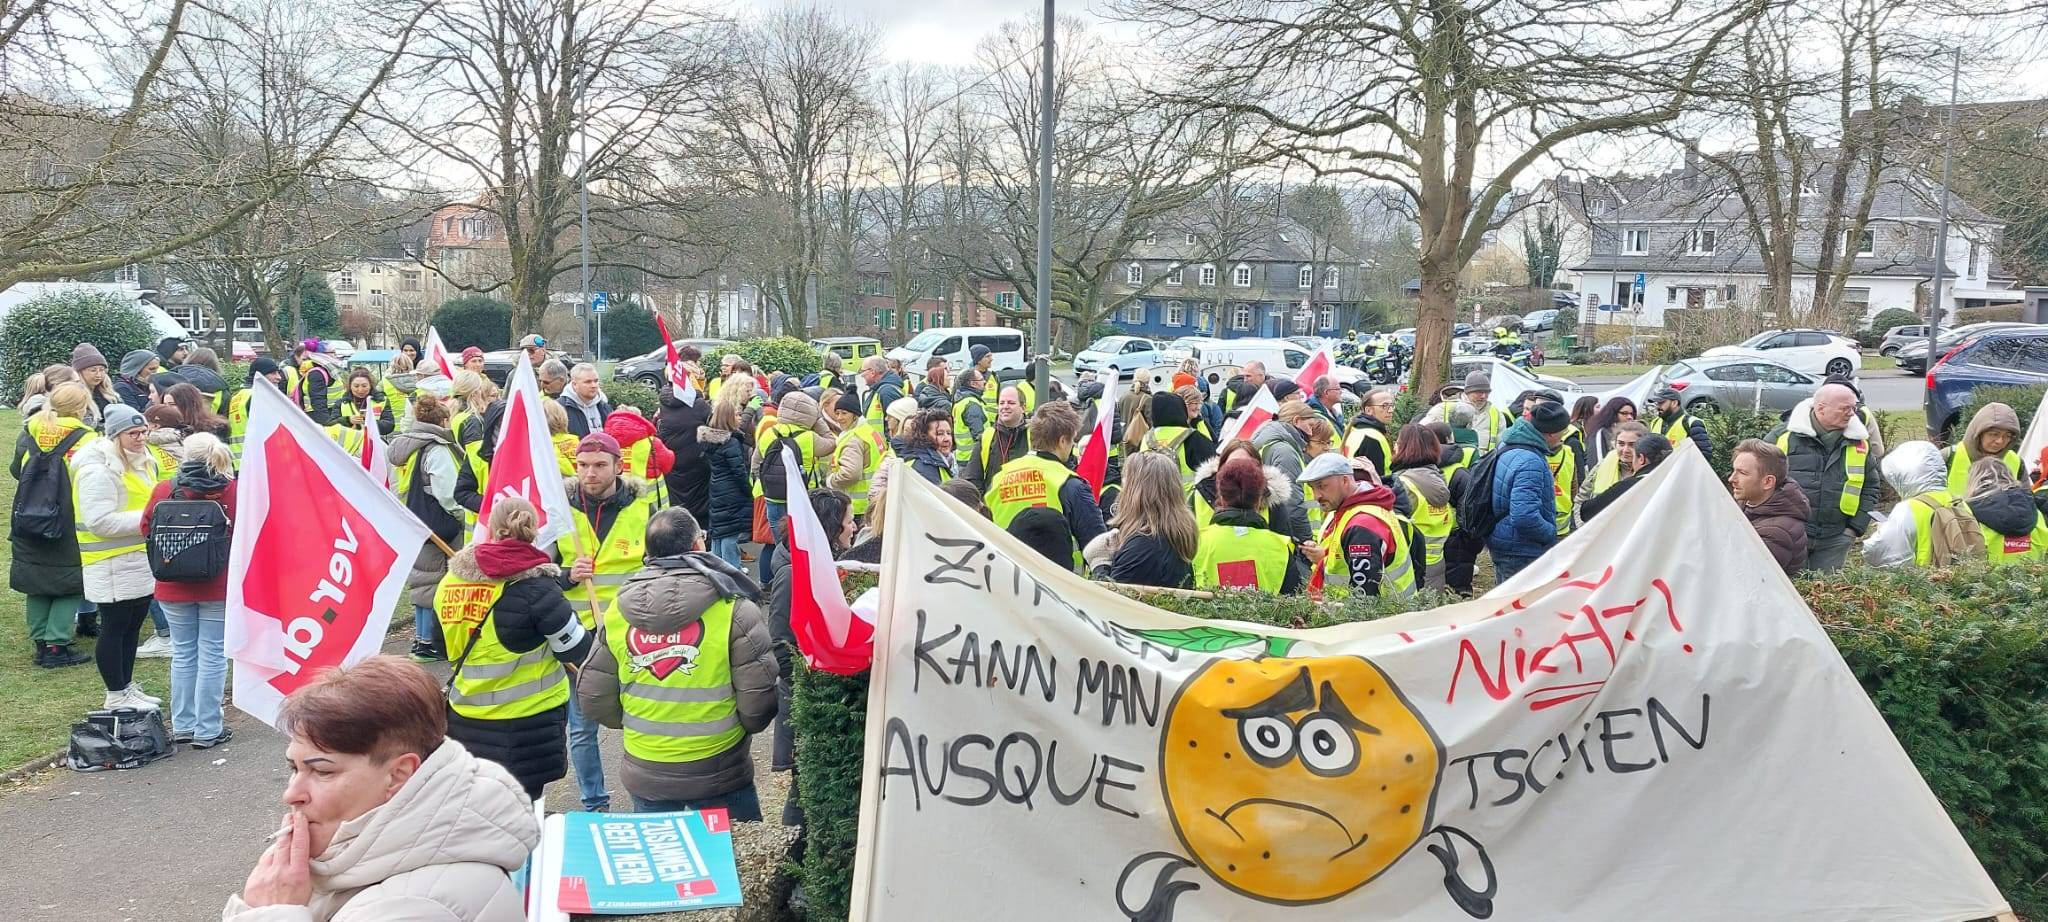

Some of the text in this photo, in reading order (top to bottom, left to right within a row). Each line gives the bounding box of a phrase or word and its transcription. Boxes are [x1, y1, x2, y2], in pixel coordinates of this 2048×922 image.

[1021, 483, 1046, 496] MEHR
[913, 609, 1162, 727] KANN MAN
[880, 717, 1146, 819] AUSQUE
[602, 822, 643, 850] GEHT
[639, 818, 697, 882] ZUSAMMEN
